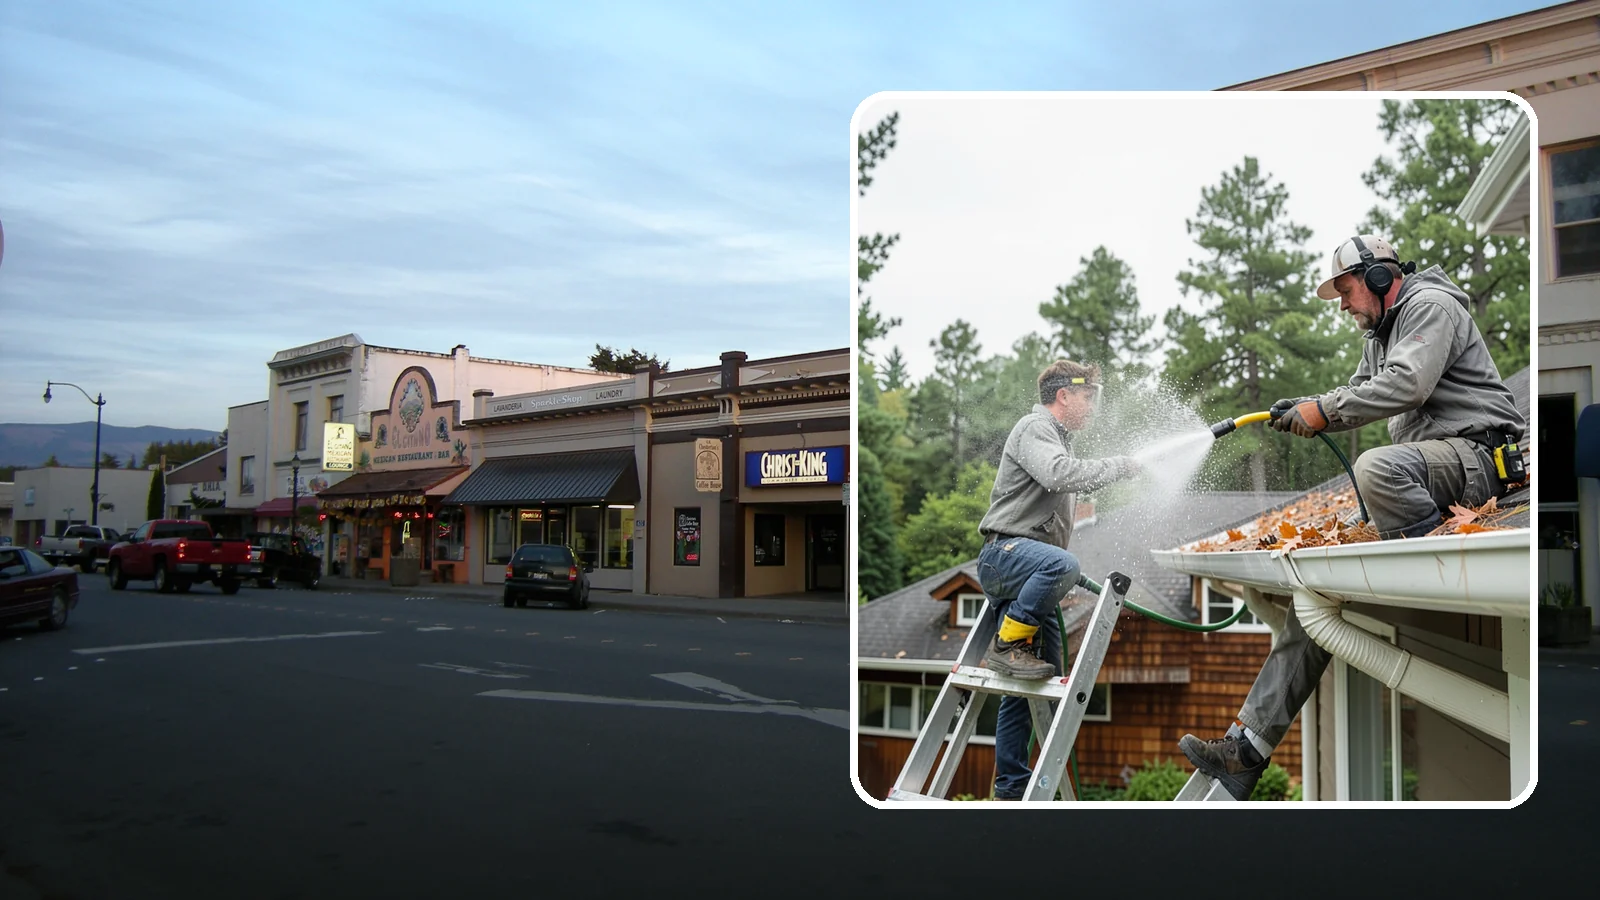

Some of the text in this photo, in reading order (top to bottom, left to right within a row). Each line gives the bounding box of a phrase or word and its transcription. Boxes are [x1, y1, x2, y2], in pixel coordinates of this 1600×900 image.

[494, 389, 624, 413] LAVANDERIA Sparkle Shop LAUNDRY
[373, 450, 450, 464] MEXICAN RESTAURANT BAR
[761, 449, 828, 478] CHRIST KING
[696, 480, 709, 489] Coffee
